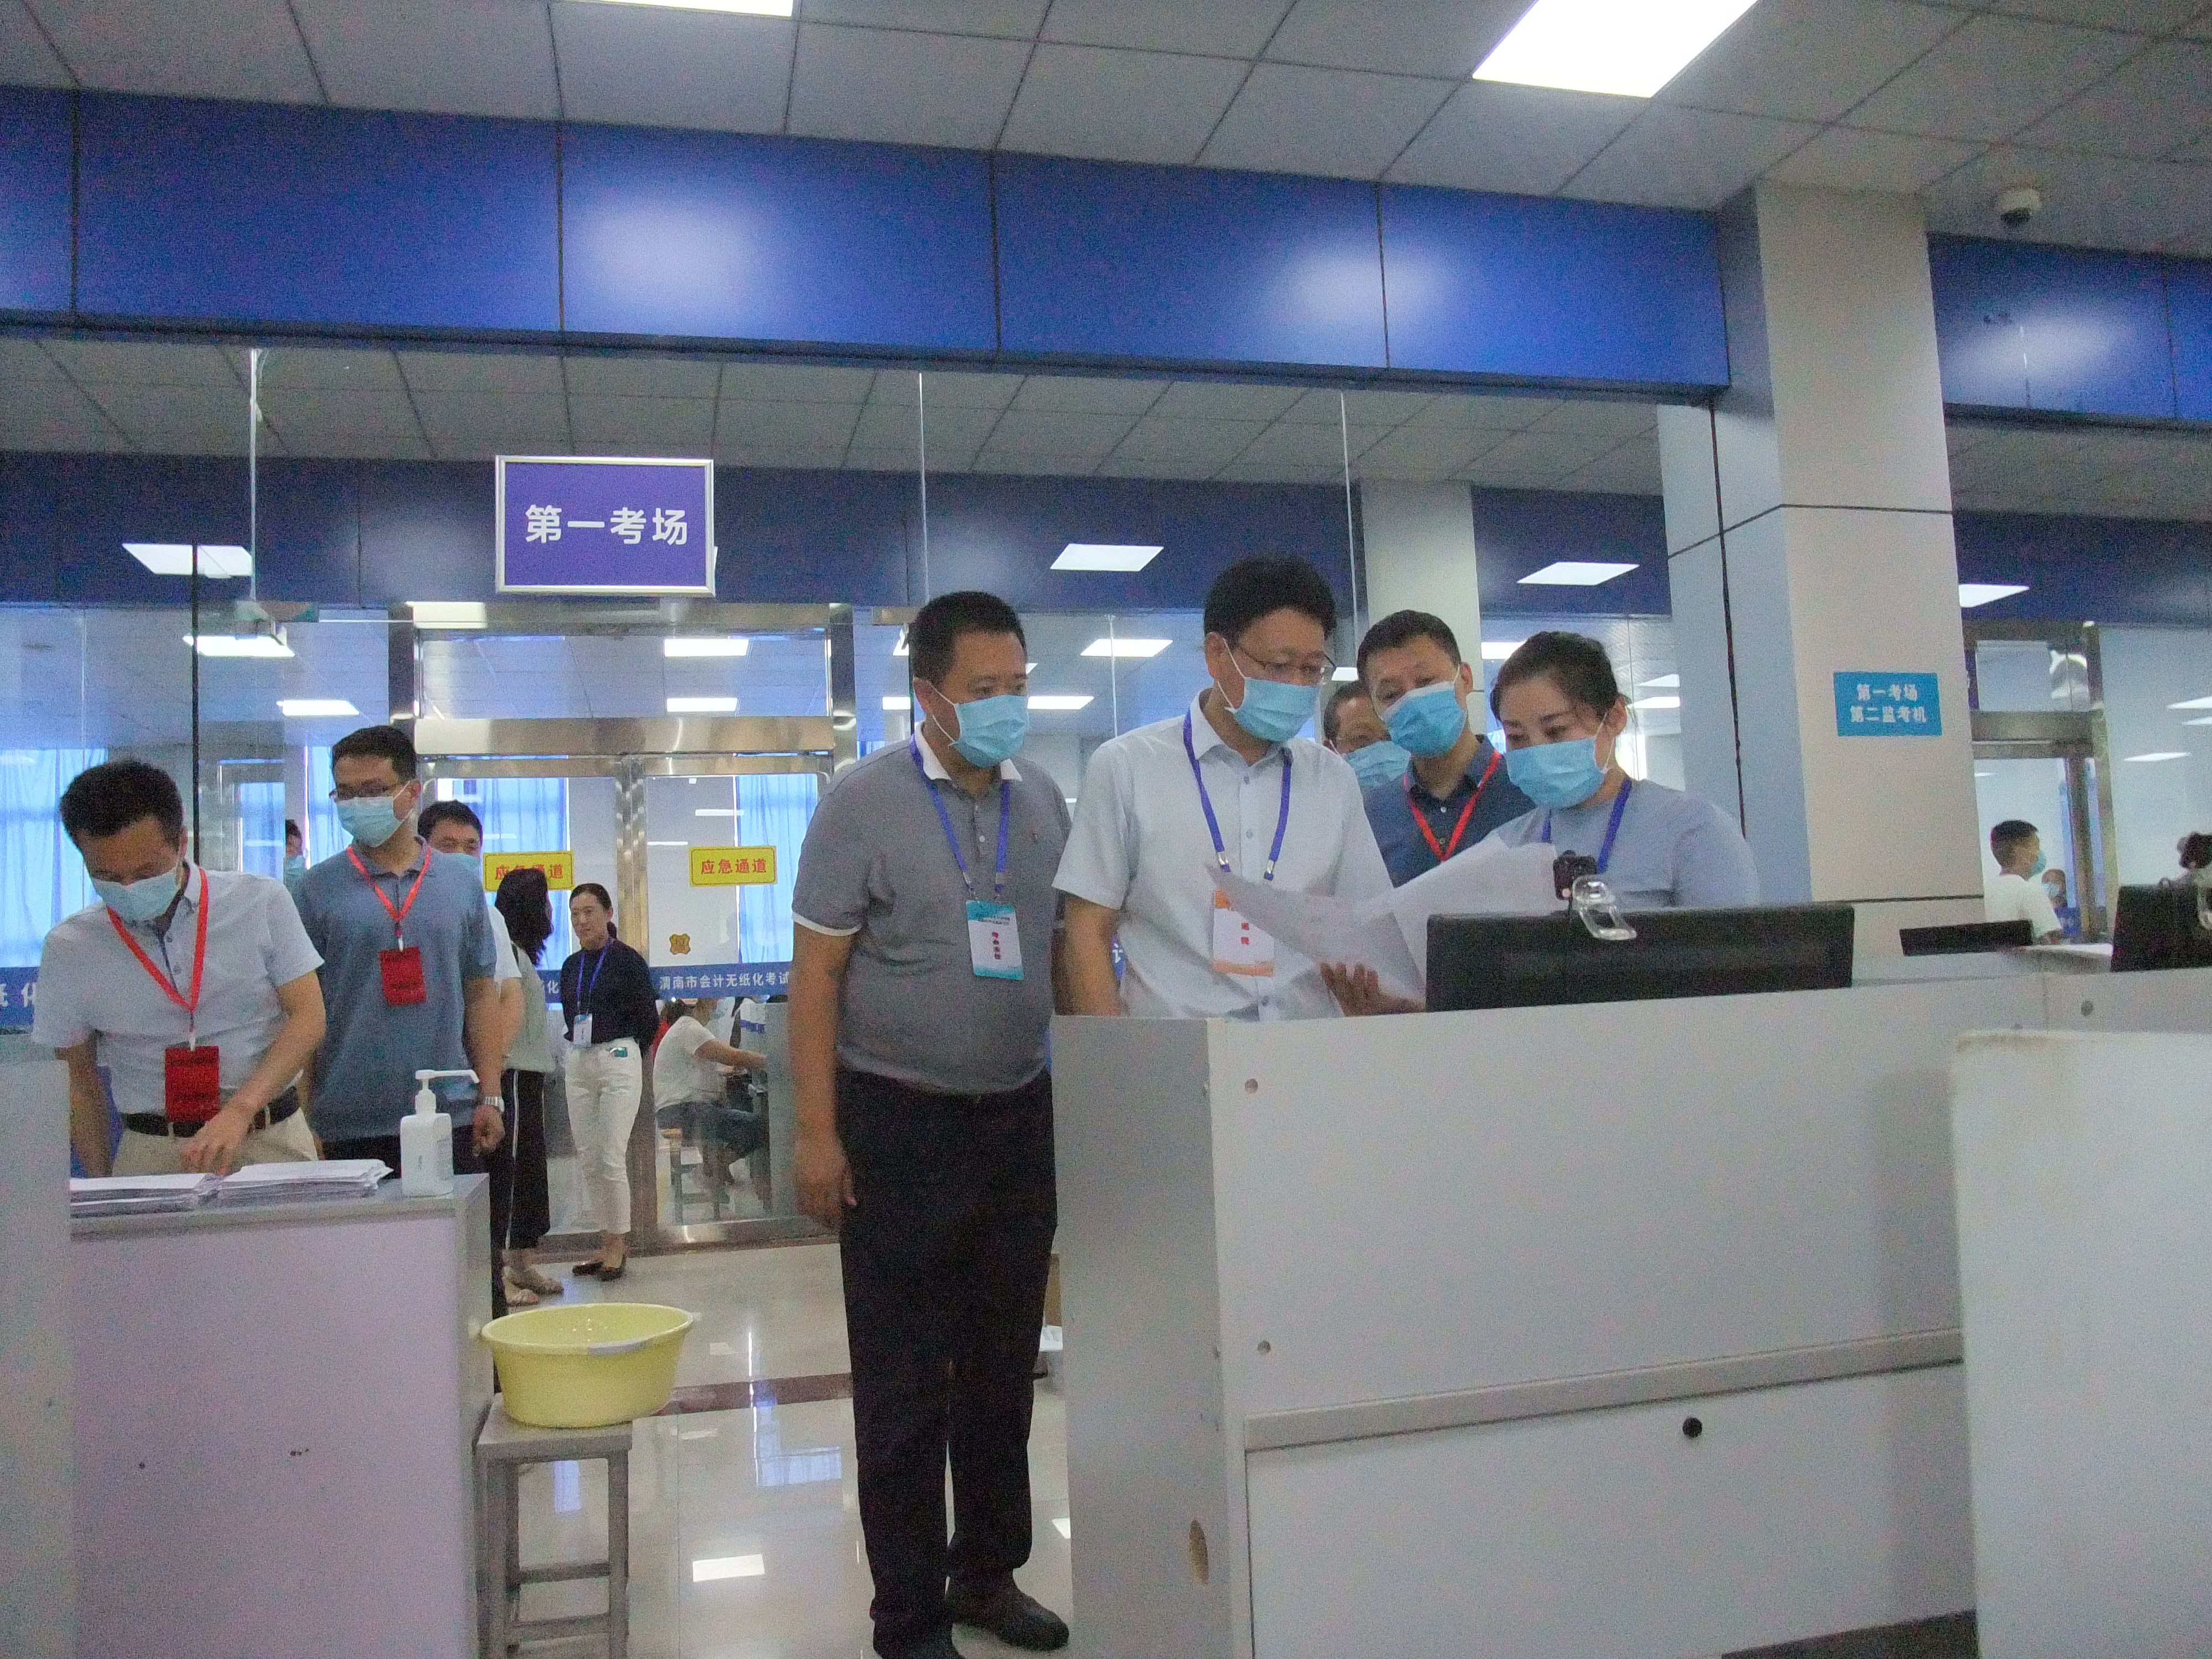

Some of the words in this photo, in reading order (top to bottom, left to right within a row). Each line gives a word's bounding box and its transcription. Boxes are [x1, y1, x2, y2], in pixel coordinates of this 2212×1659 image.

[524, 504, 688, 546] 第一考场
[1856, 683, 1918, 702] 第一考场
[701, 858, 766, 875] 应急通道
[659, 971, 789, 990] 渭南市会计无纸化考试
